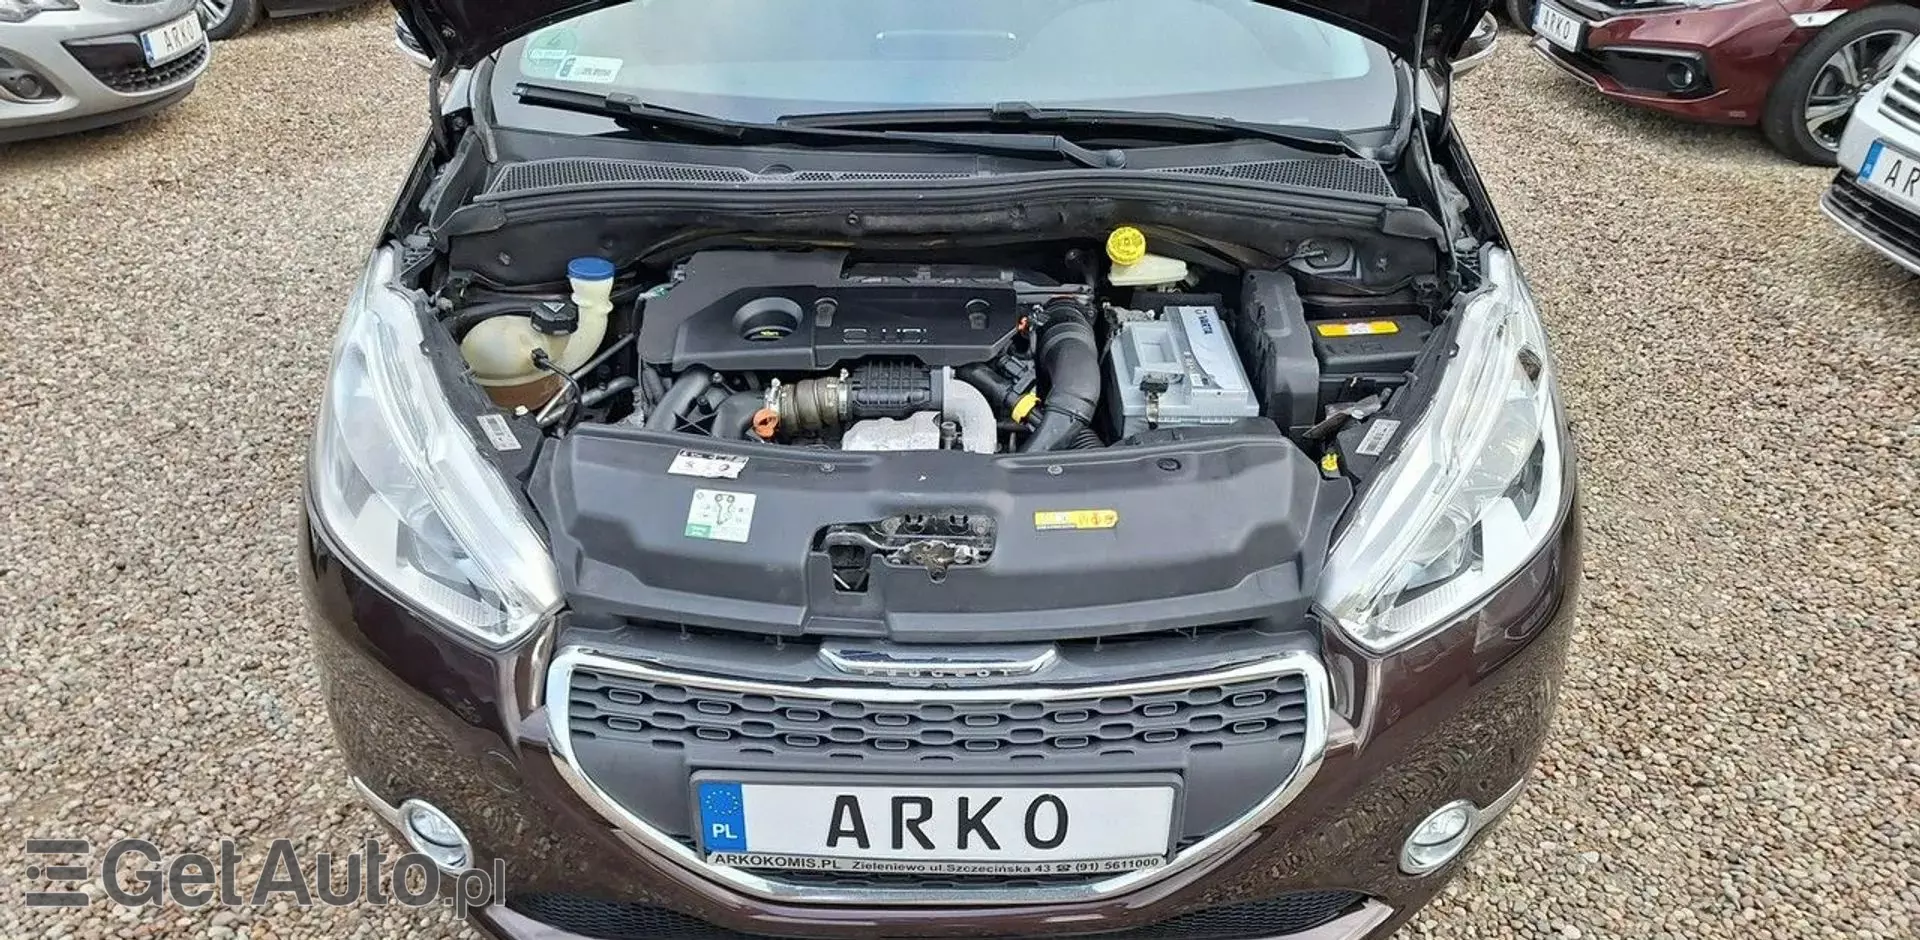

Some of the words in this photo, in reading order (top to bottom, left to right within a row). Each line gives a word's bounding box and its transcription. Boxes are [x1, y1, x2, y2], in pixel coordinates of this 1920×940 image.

[713, 824, 738, 840] PL
[826, 794, 1069, 851] ARKO
[714, 854, 842, 870] ARKOKOMIS.PL
[851, 861, 926, 872] Zieleniewo
[1035, 865, 1051, 873] 43
[1075, 862, 1100, 872] (91)
[1104, 858, 1160, 870] 5611000
